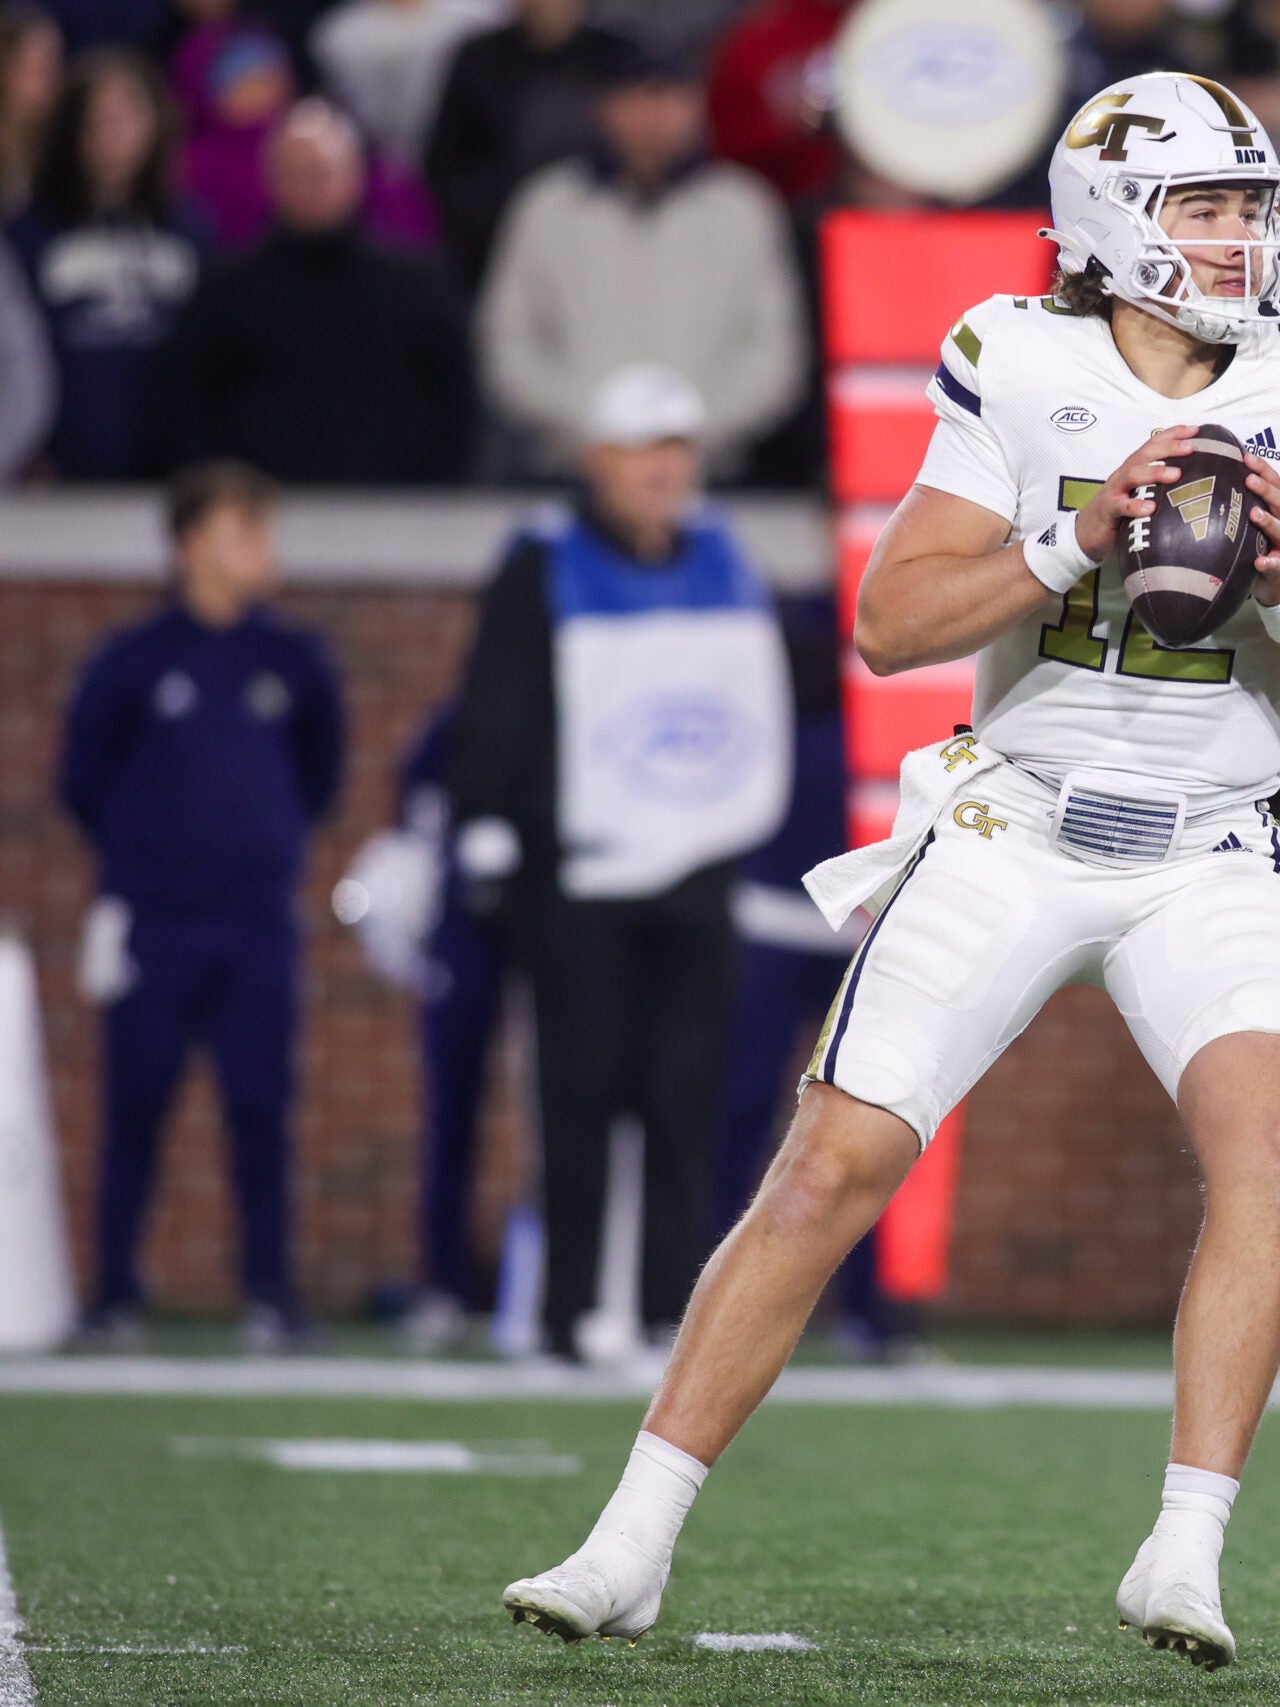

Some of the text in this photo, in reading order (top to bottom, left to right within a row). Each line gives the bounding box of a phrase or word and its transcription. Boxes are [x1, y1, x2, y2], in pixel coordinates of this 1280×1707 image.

[1057, 412, 1090, 421] ACC
[1224, 487, 1243, 543] DIME
[953, 801, 1008, 840] GT
